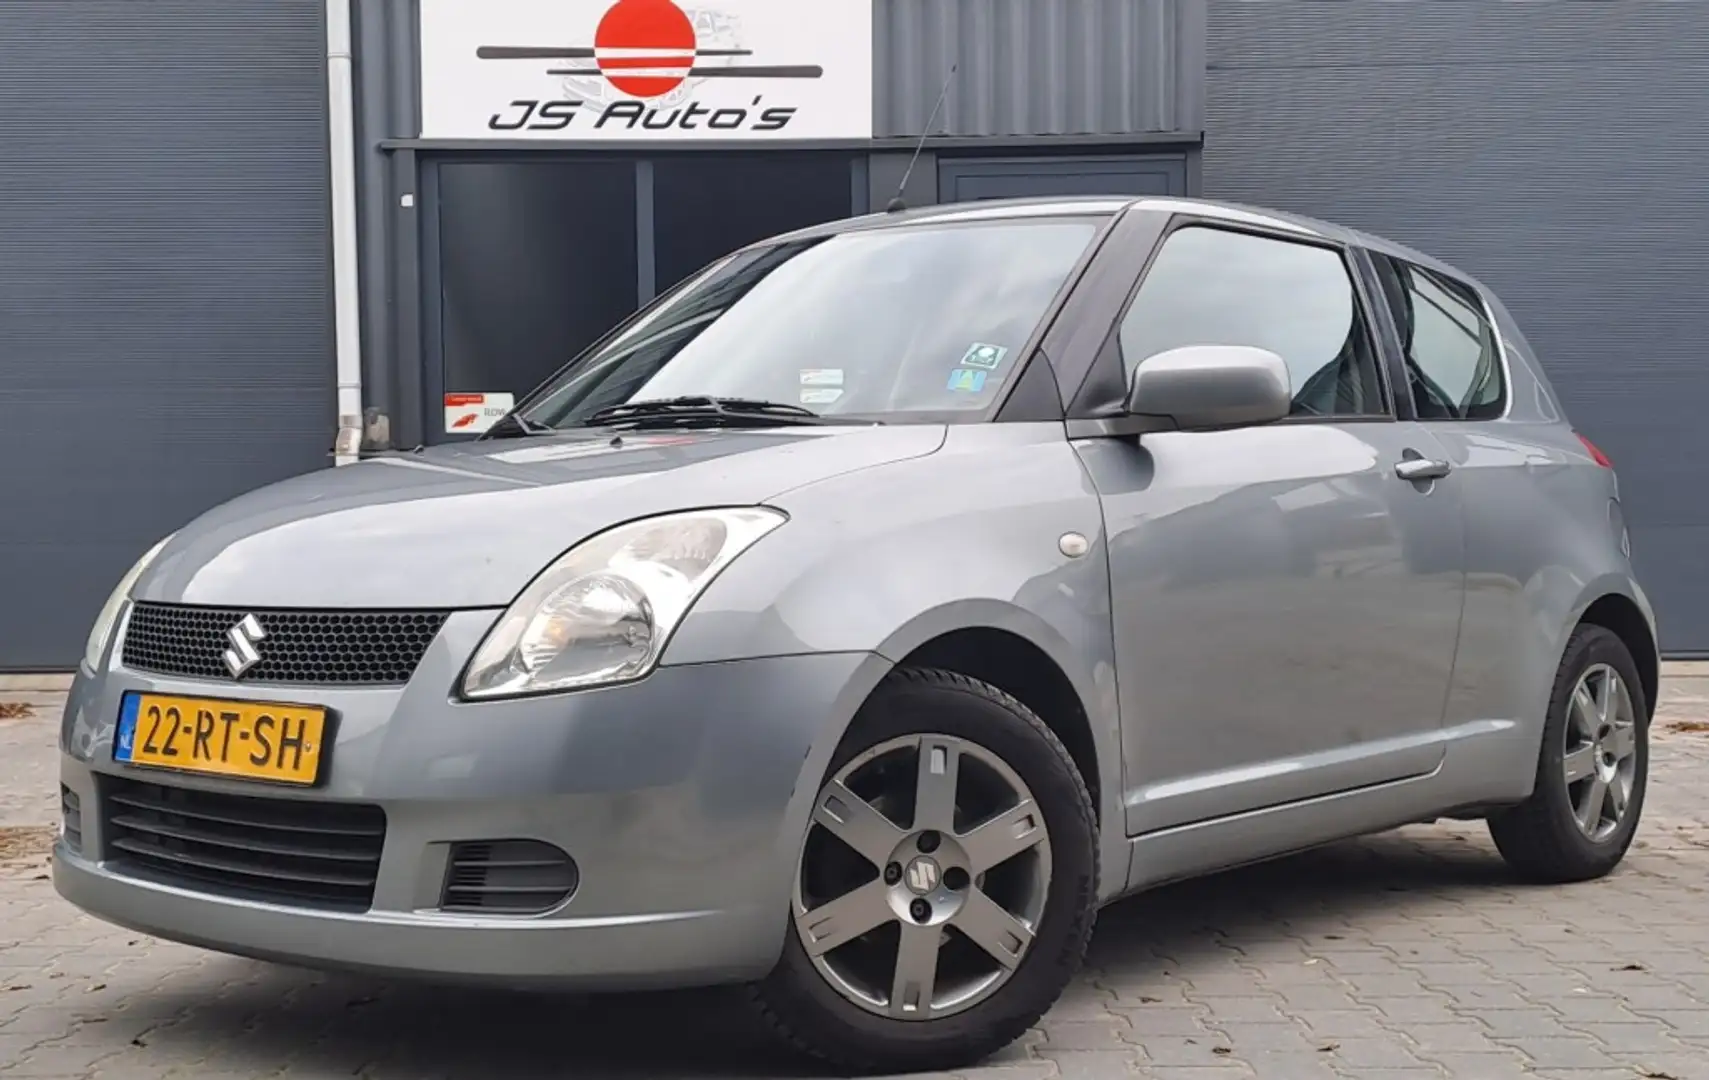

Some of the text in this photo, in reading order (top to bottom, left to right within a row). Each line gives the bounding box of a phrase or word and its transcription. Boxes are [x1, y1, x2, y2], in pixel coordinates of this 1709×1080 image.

[488, 95, 798, 131] JS Auto's
[142, 705, 306, 771] 22-RT-SH
